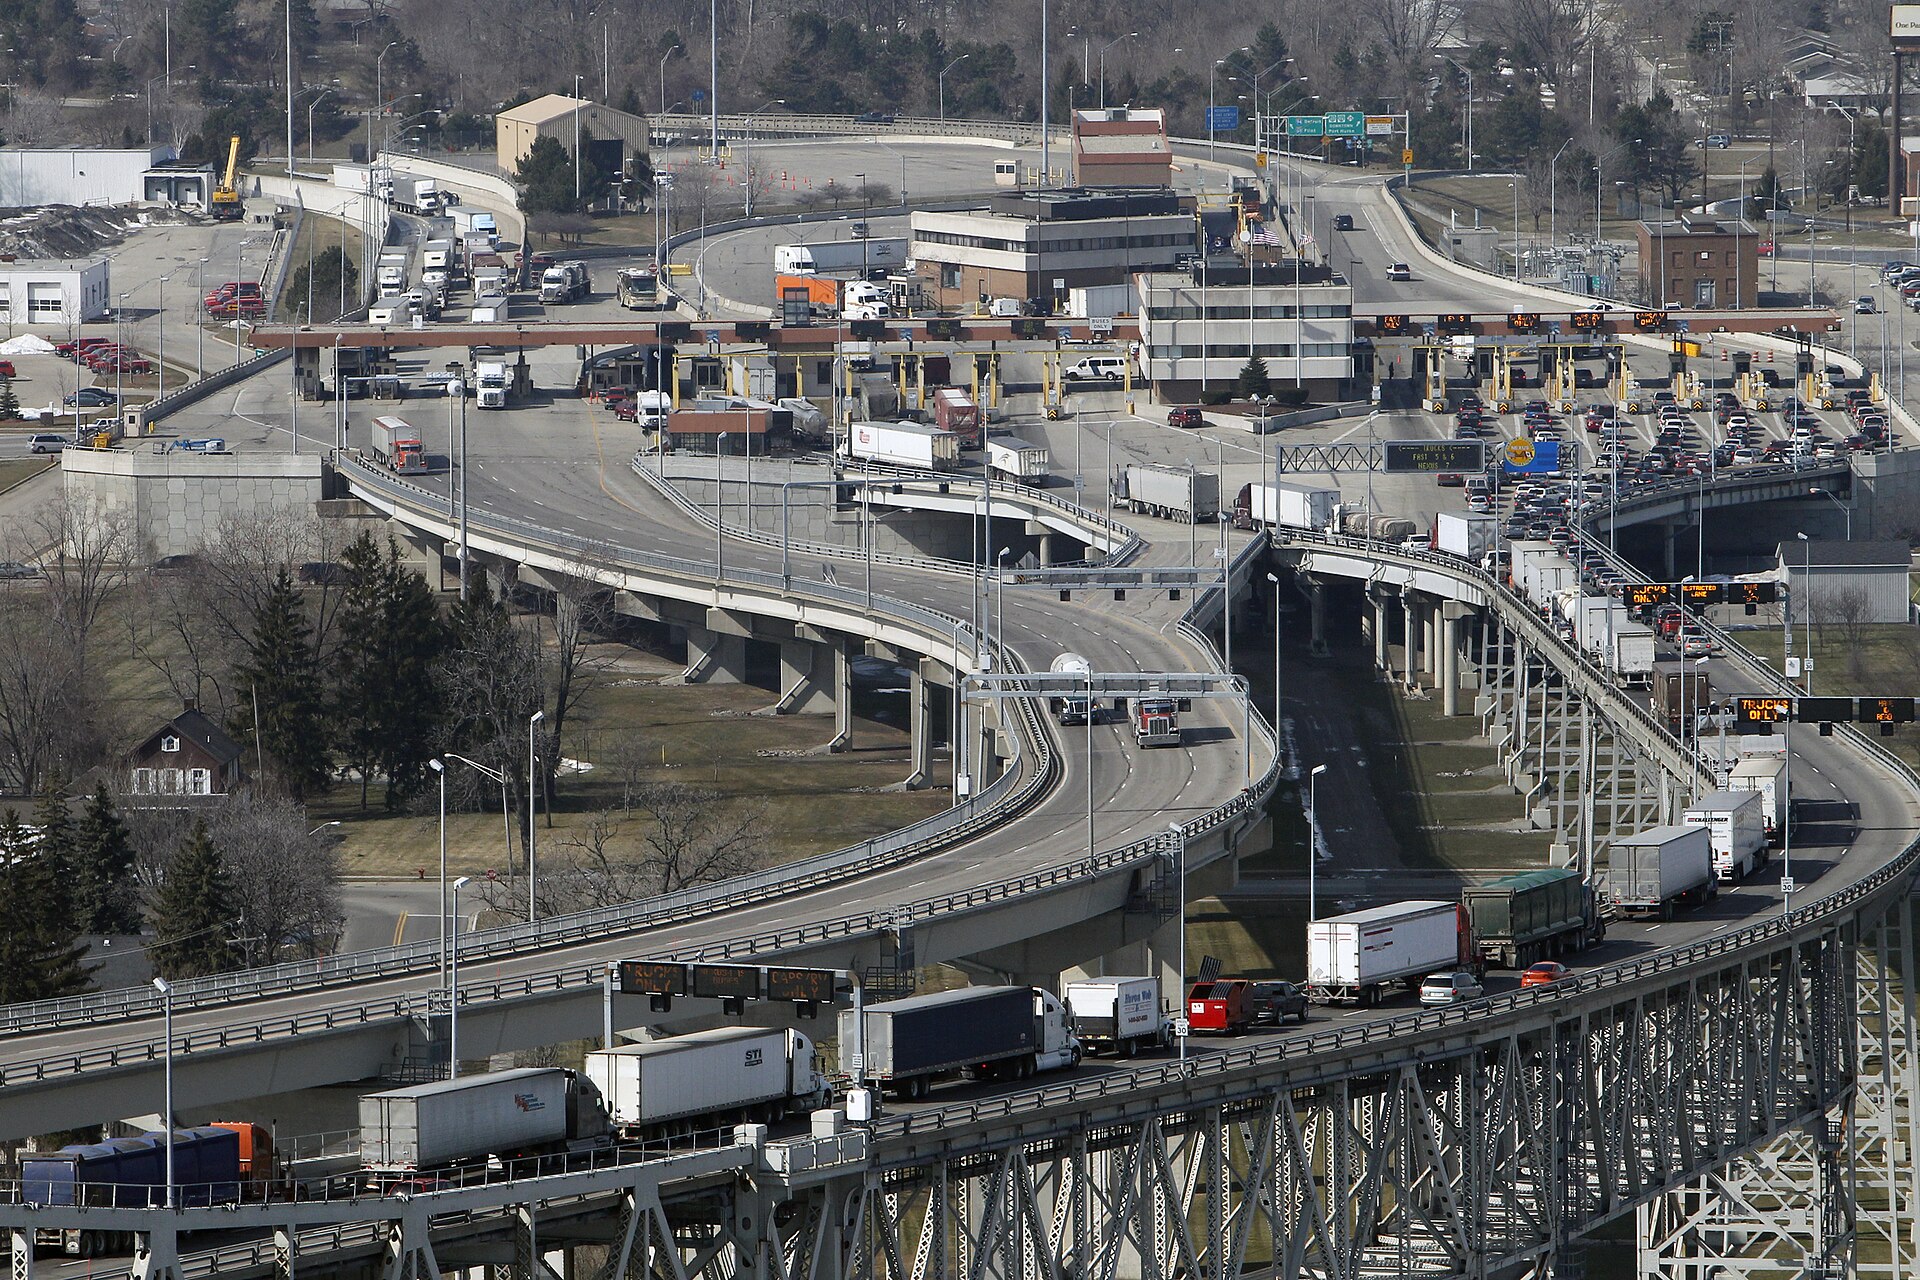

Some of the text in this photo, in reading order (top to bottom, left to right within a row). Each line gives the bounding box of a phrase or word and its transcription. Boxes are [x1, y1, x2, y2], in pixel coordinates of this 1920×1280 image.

[1412, 453, 1428, 461] FAST
[1417, 462, 1439, 470] NEXUS
[1633, 594, 1660, 603] ONLY
[1749, 710, 1779, 720] ONLY
[745, 1048, 762, 1060] STI
